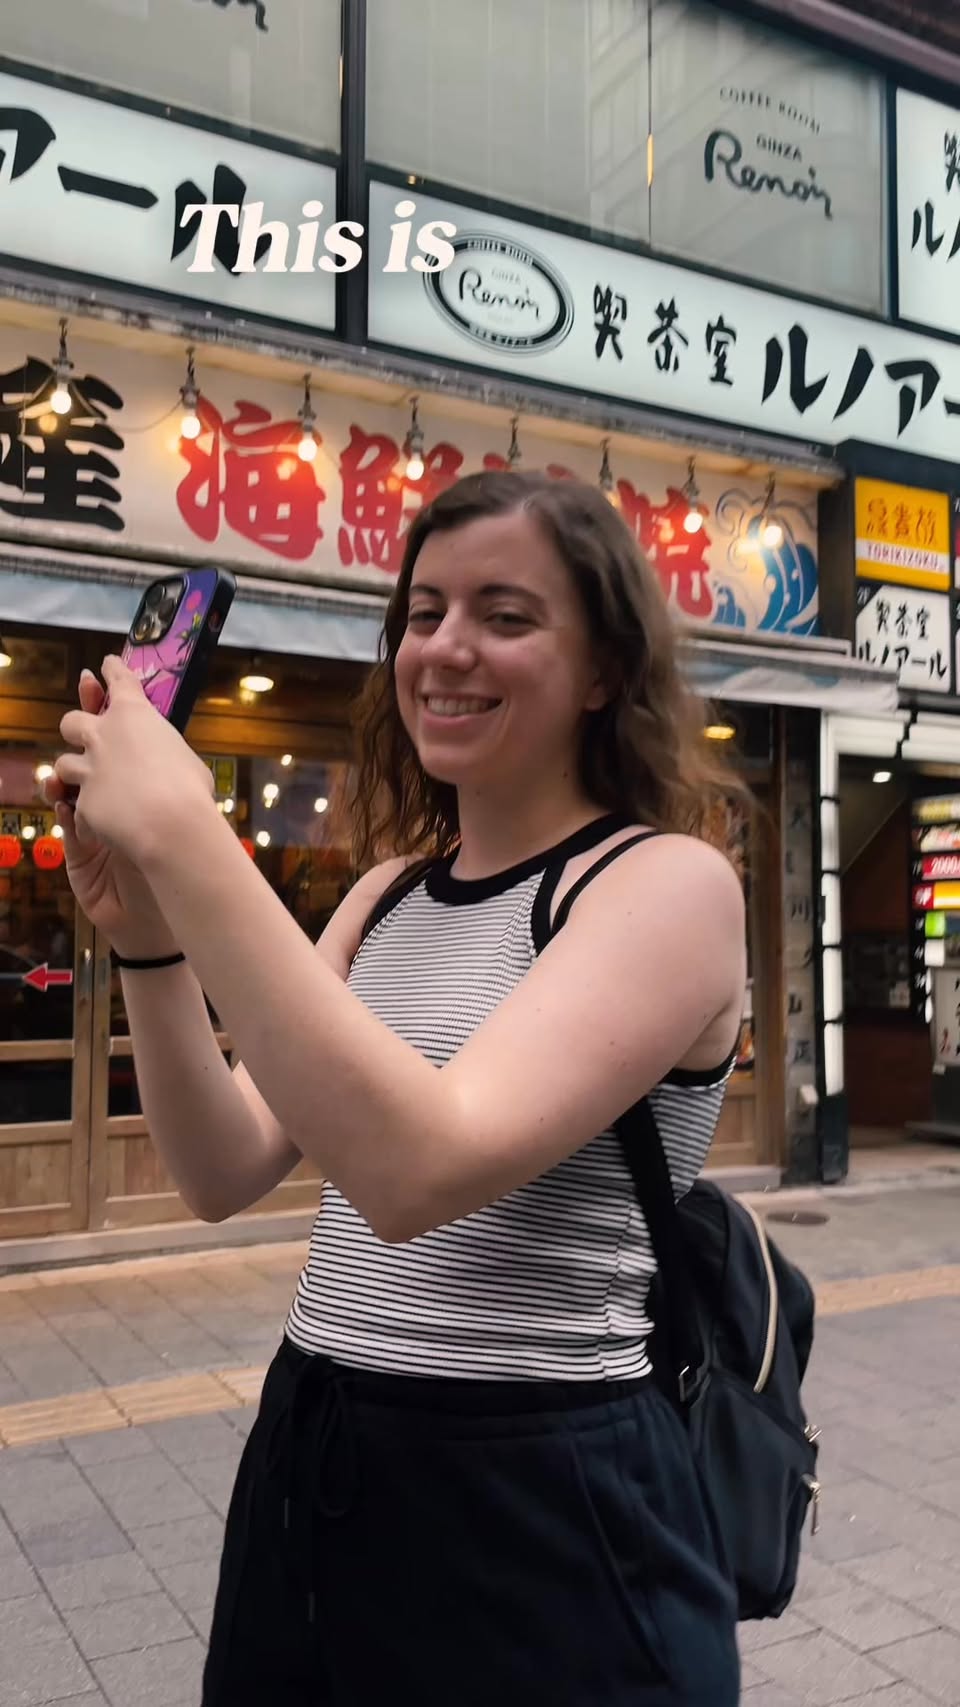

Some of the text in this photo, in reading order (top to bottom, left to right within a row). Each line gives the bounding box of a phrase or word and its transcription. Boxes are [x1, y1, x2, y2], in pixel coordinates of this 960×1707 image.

[593, 284, 737, 386] 喫茶室
[876, 599, 930, 640] 喫茶室
[858, 640, 948, 678] ルノアール
